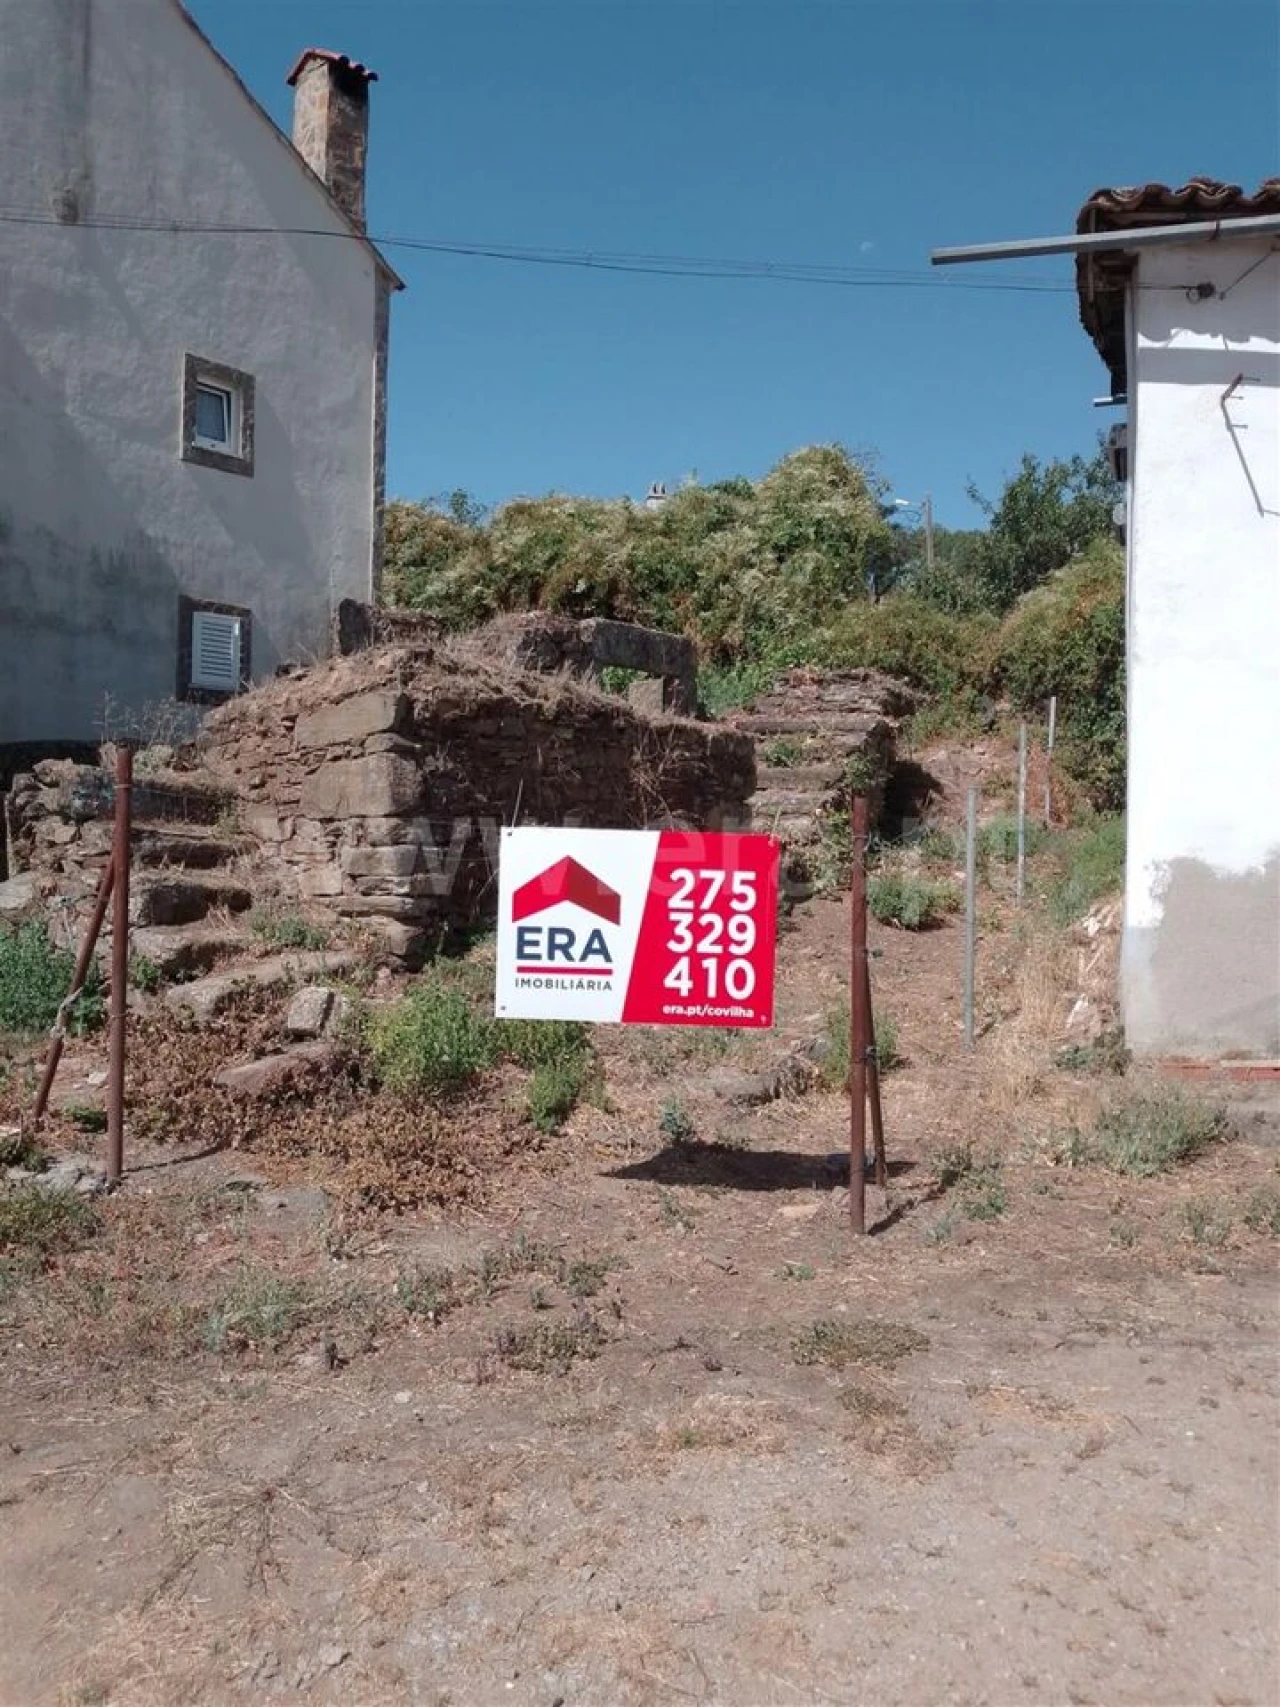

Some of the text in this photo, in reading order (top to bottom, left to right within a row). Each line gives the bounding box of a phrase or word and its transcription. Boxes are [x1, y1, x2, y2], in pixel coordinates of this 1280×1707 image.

[667, 868, 757, 912] 275
[516, 925, 613, 963] ERA
[666, 912, 757, 956] 329
[515, 977, 613, 992] IMOBILIÁRIA
[663, 956, 756, 1000] 410
[662, 1003, 755, 1019] era.pt/covilha
